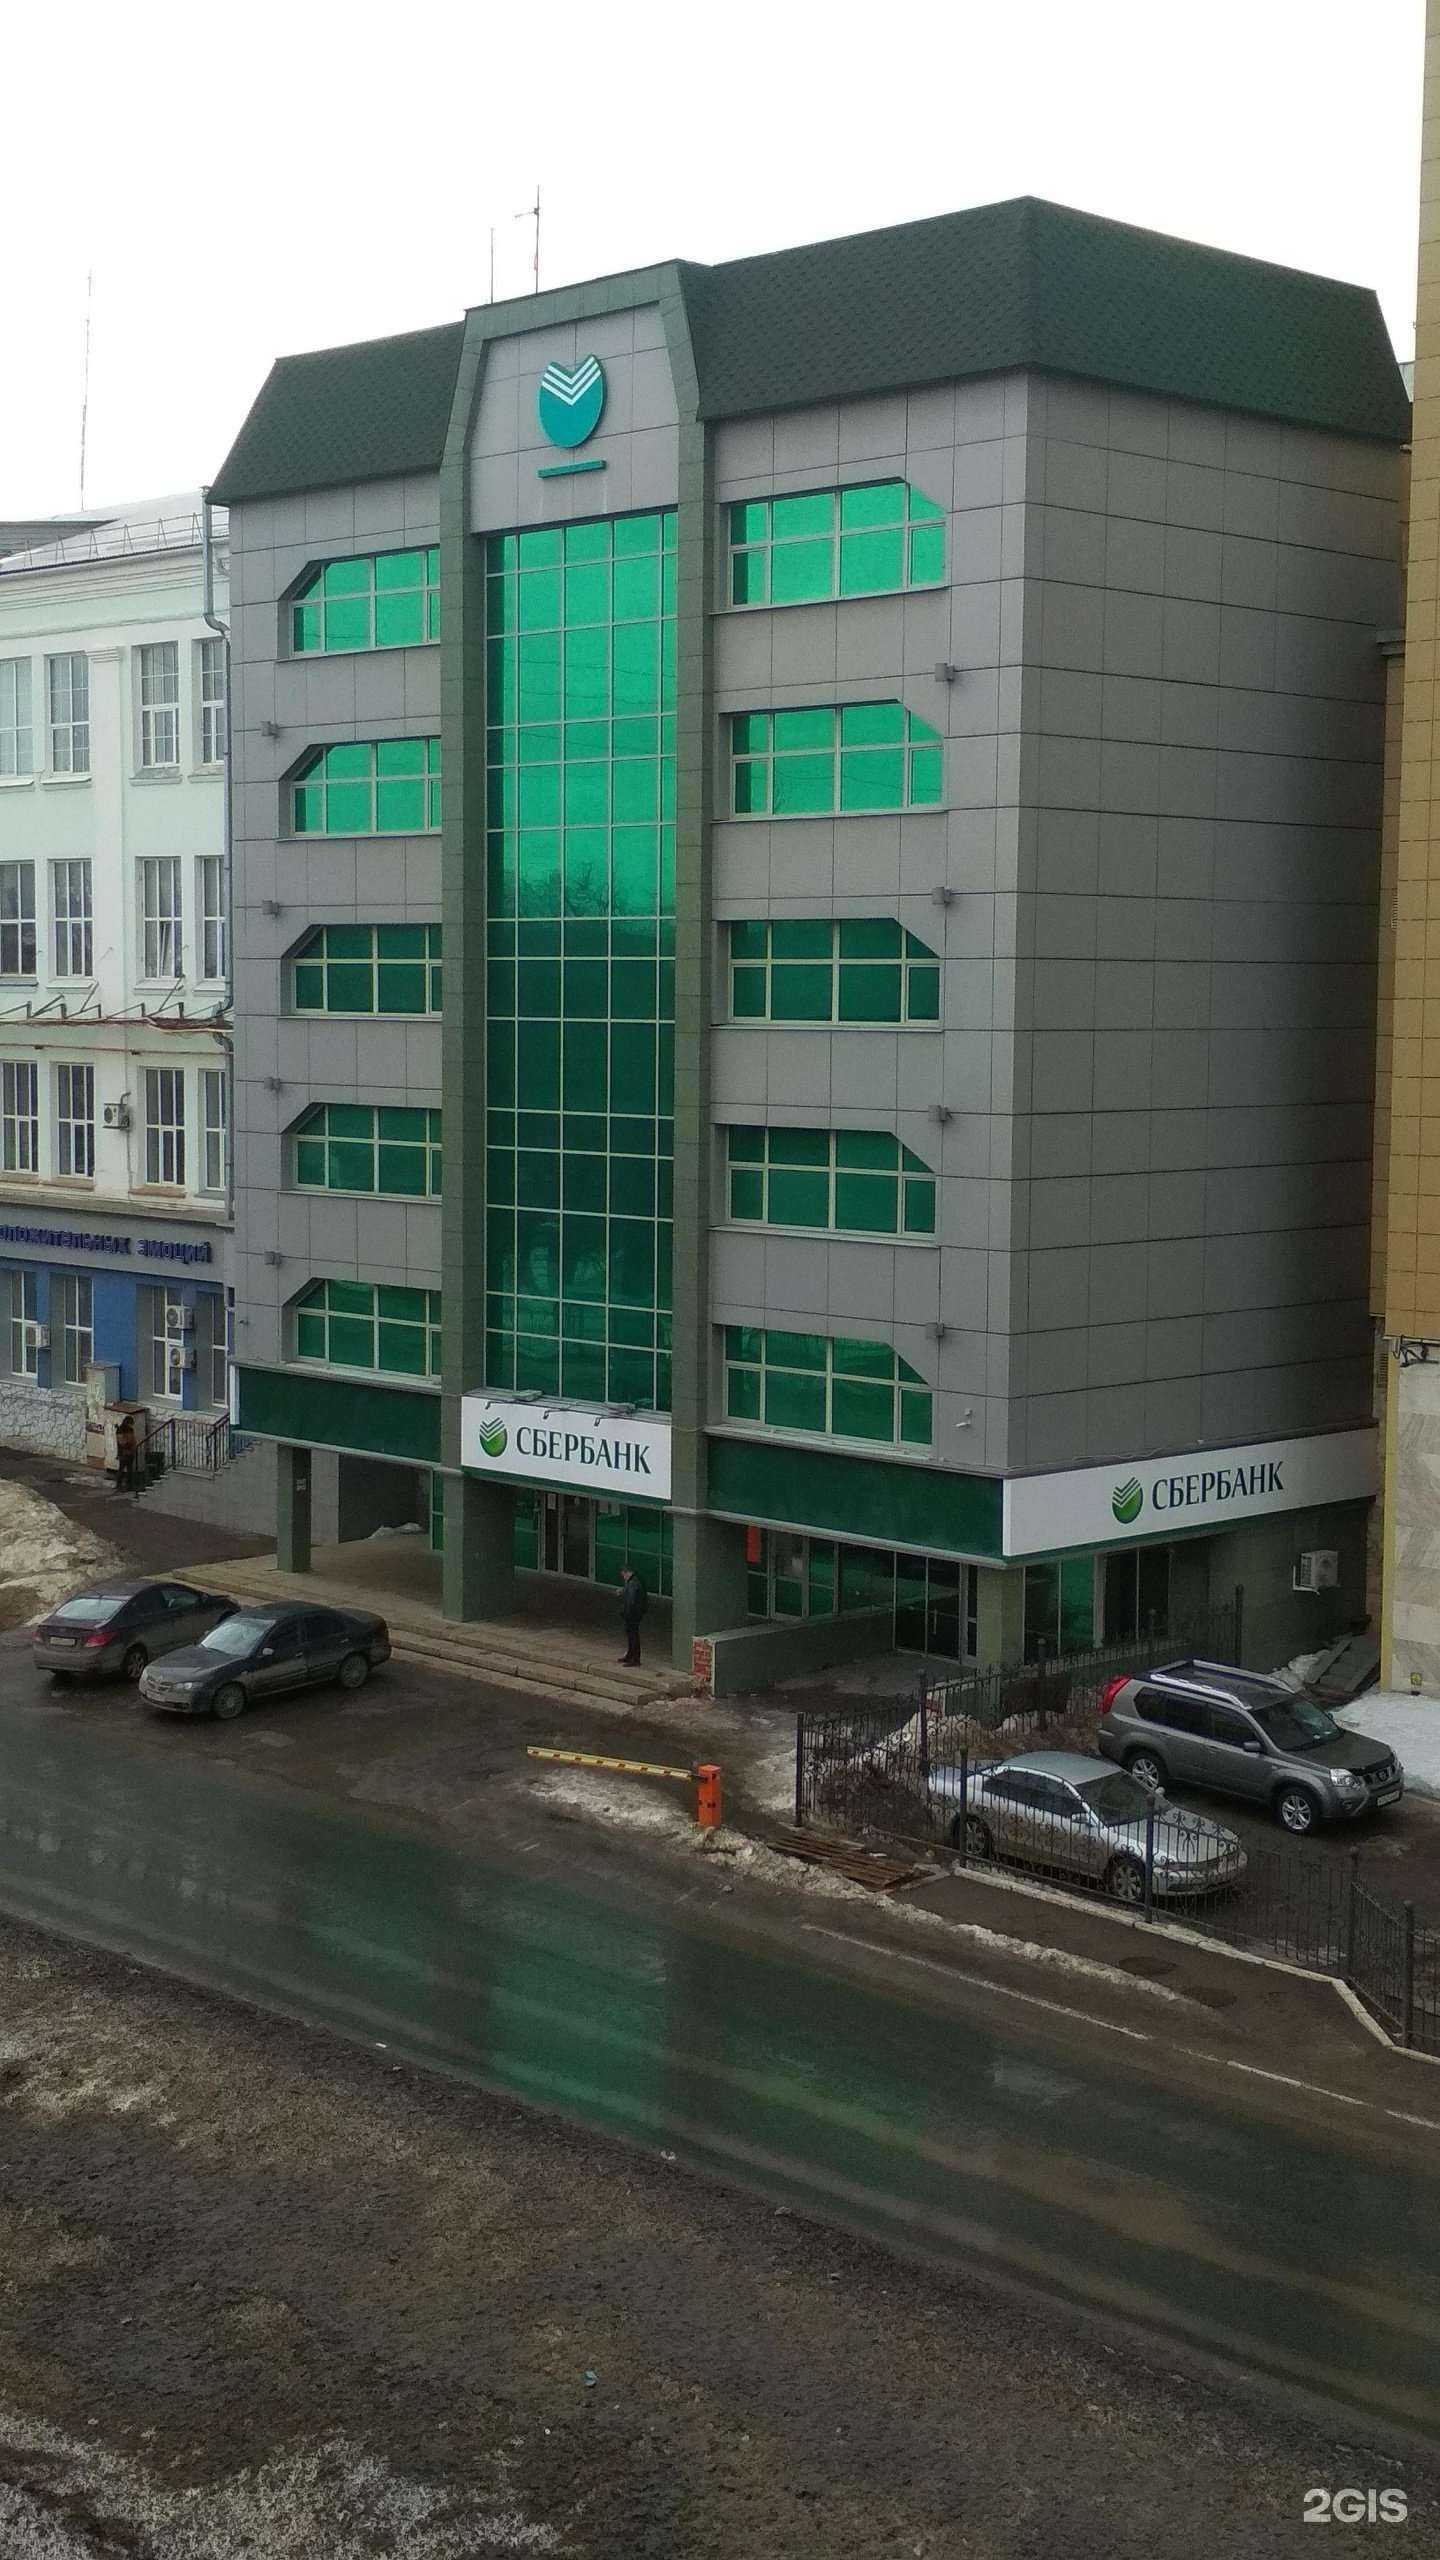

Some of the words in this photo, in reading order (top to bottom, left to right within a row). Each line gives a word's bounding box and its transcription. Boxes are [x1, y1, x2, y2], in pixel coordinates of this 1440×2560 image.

[136, 1239, 212, 1265] ЭМОЦИЙ
[516, 1426, 651, 1474] СБЕРБАНК
[1152, 1461, 1284, 1510] СБЕРБАНК
